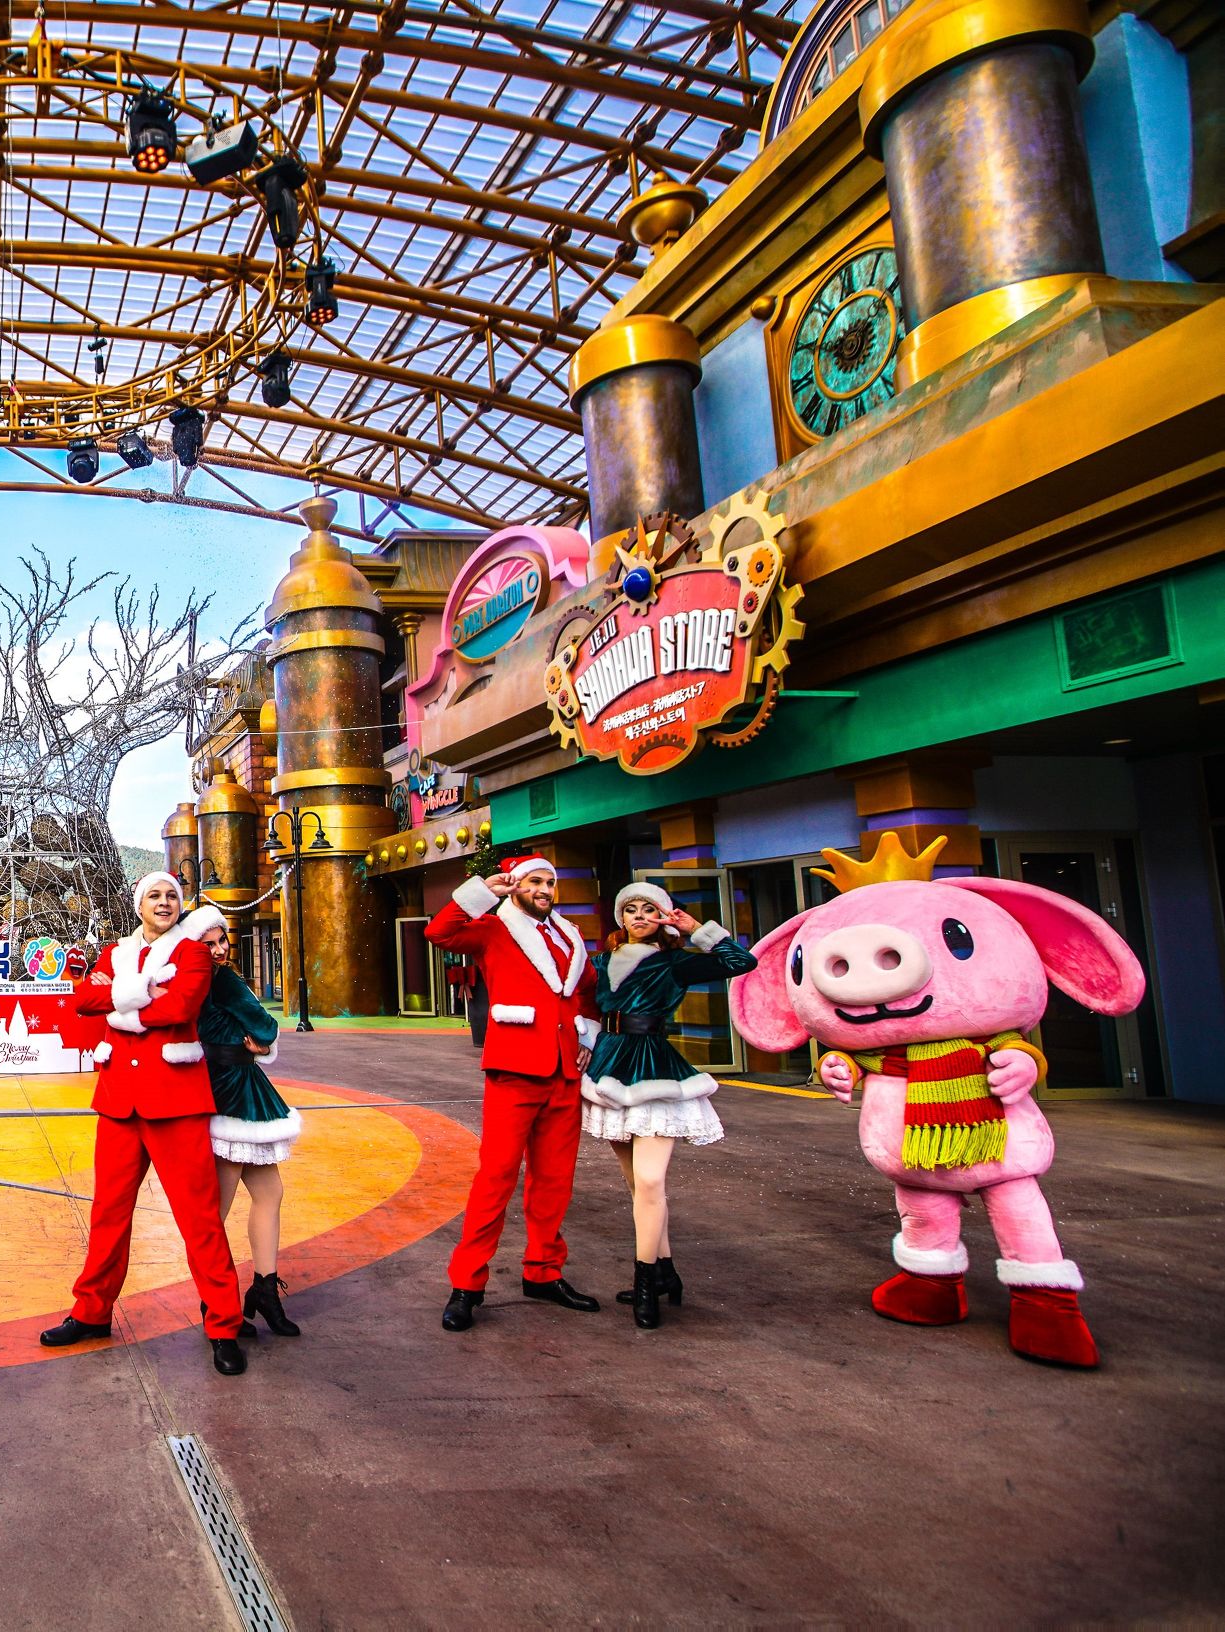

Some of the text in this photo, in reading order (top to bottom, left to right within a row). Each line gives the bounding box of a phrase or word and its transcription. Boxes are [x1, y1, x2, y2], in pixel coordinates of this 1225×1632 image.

[589, 614, 620, 656] JEJU
[574, 625, 657, 726] SHINHWA
[659, 607, 738, 676] STORE
[419, 773, 436, 796] CAFE
[0, 1042, 31, 1055] Merry
